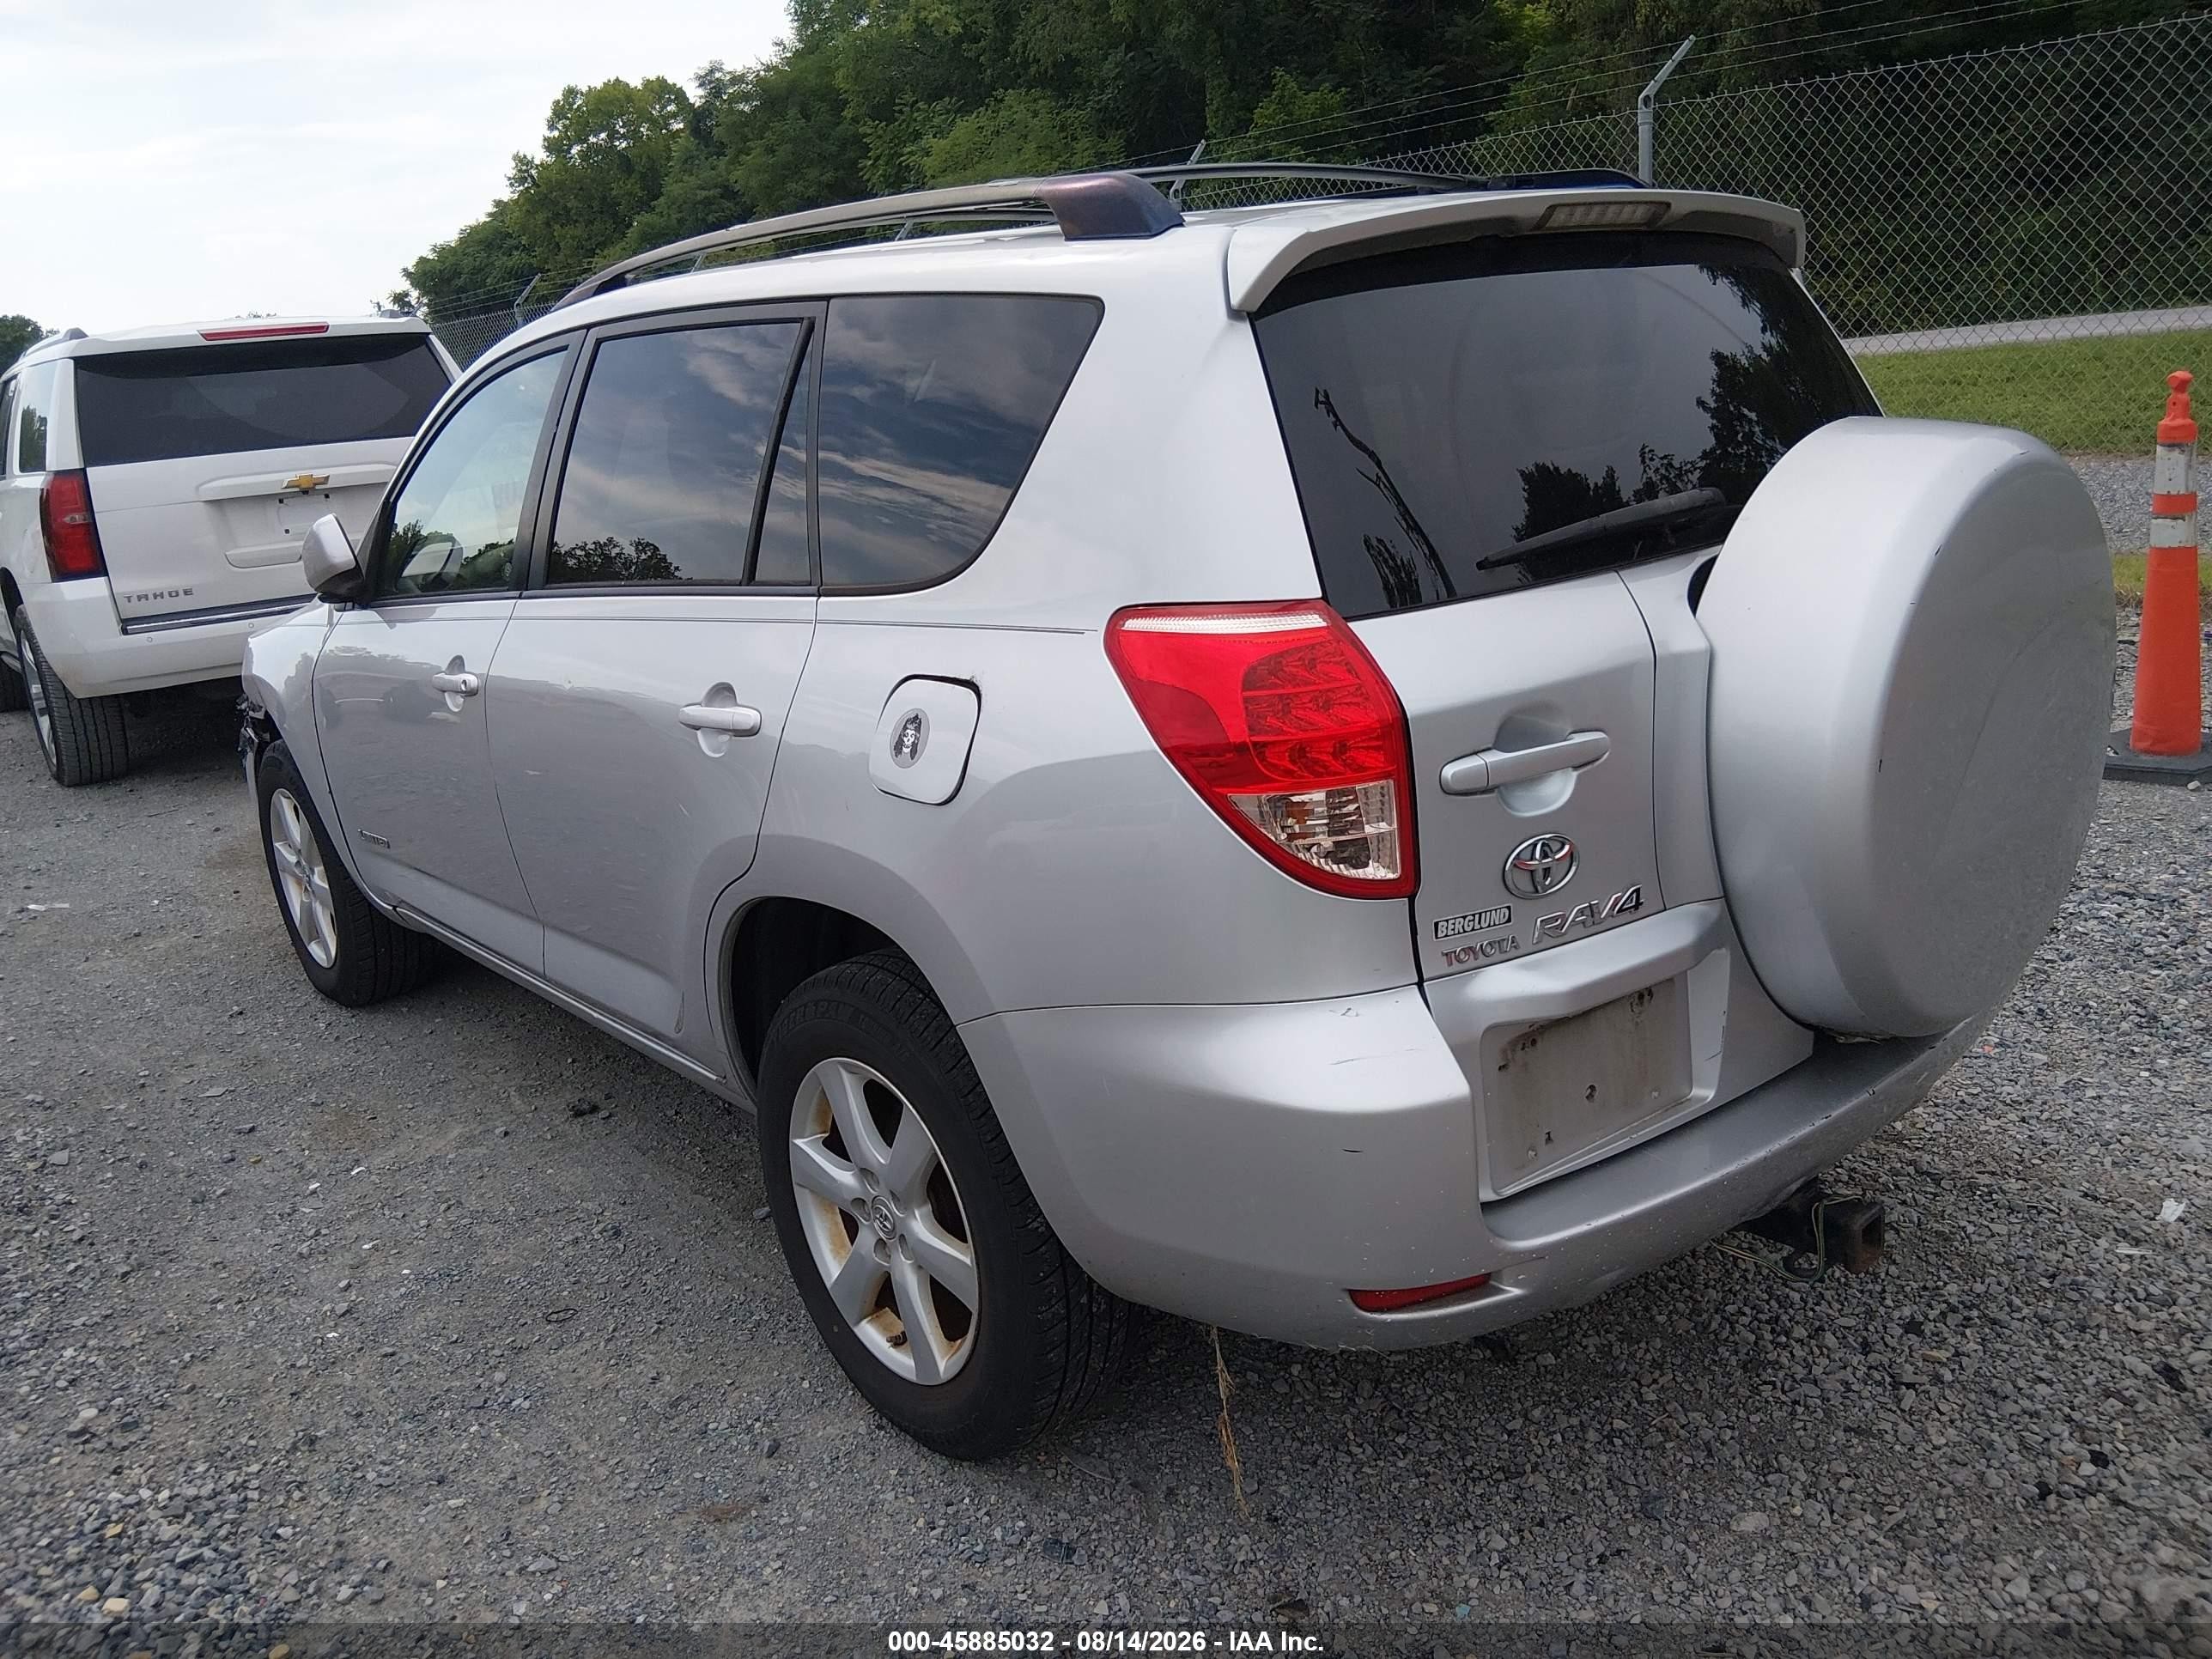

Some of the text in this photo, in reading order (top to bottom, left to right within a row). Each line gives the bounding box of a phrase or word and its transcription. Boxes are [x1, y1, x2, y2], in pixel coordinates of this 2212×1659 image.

[123, 587, 194, 604] TAHOE
[1437, 907, 1510, 939] BERGLUND
[1532, 884, 1644, 945] RAV4
[1441, 935, 1521, 967] TOYOTA
